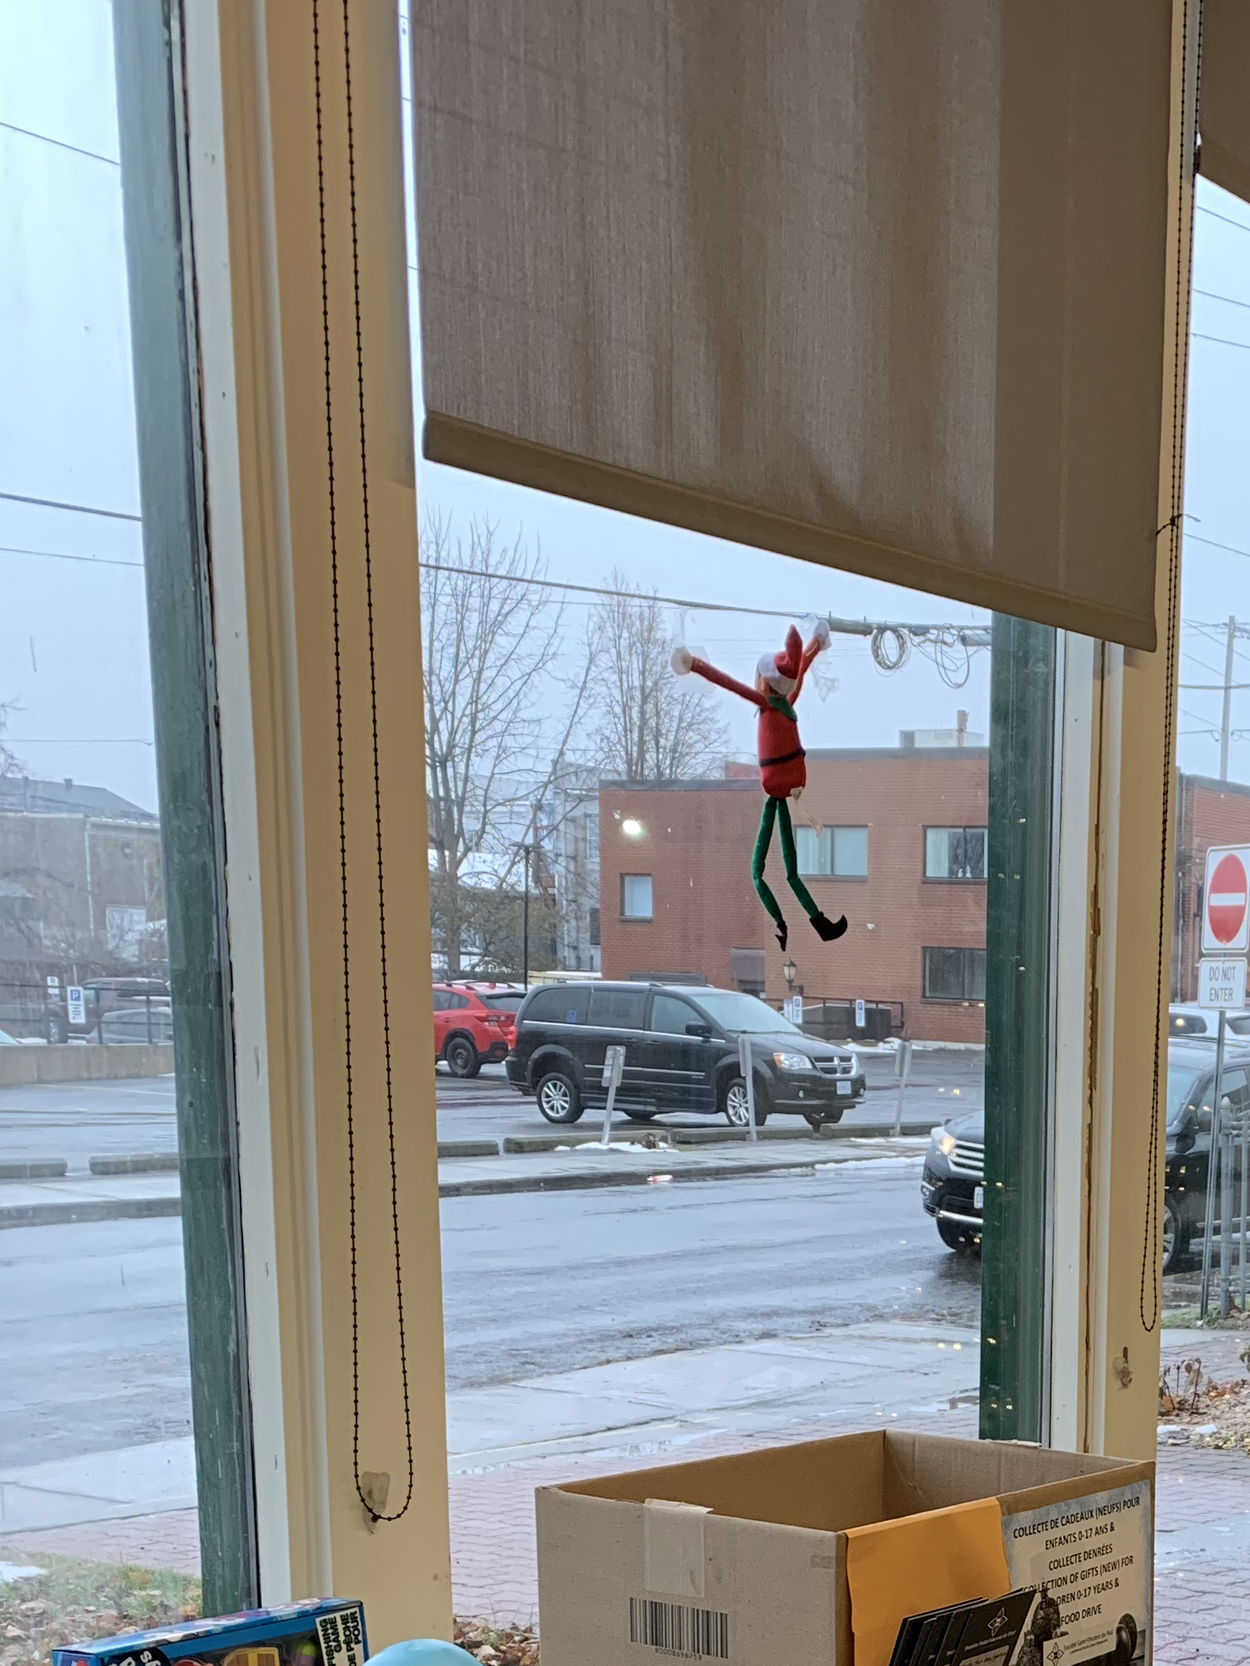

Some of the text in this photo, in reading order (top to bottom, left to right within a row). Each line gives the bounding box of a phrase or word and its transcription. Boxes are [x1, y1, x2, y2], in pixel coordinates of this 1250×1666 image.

[1209, 966, 1236, 981] DO NOT
[1210, 988, 1233, 1001] ENTER
[1014, 1497, 1140, 1538] COLLECTE DE CADEAUX (NEUFS) POUR
[1046, 1522, 1115, 1550] ENFANTS 0-17 ANS &
[1049, 1543, 1113, 1571] COLLECTE DENRÉES
[1070, 1555, 1134, 1583] OF GIFTS (NEW) FOR
[1077, 1578, 1119, 1600] 0-17 YEARS &
[350, 1611, 362, 1644] POUR
[1060, 1604, 1102, 1626] FOOD DRIVE
[331, 1616, 342, 1653] GAME
[340, 1612, 355, 1651] PÊCHE
